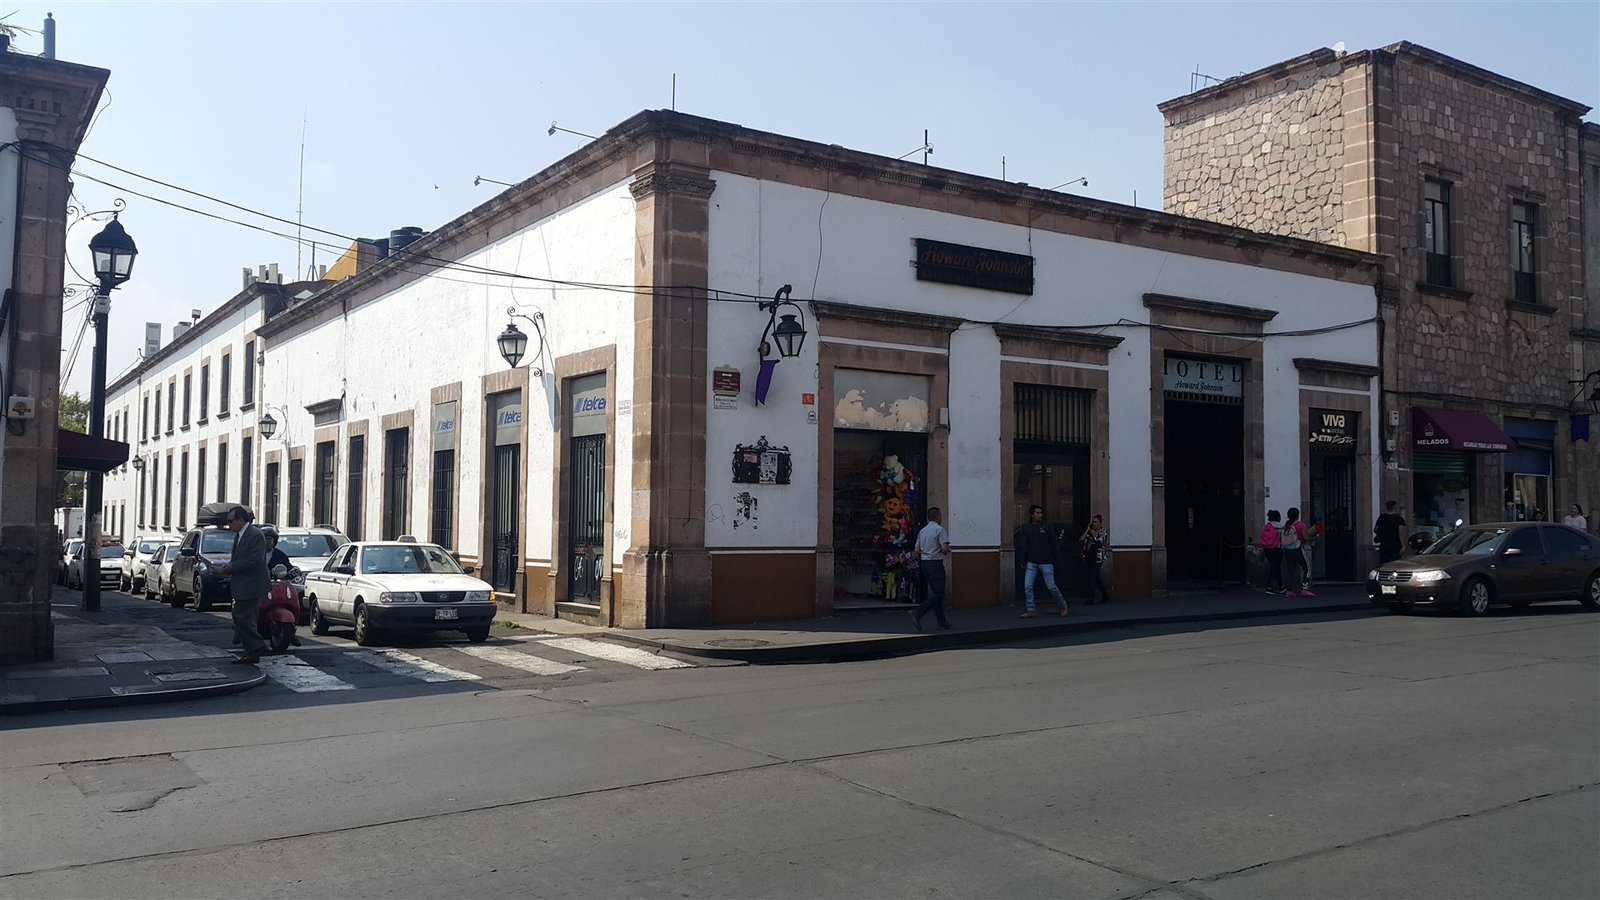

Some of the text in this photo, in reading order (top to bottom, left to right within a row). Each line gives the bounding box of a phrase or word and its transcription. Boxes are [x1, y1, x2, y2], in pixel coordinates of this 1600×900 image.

[1174, 380, 1223, 393] Howard Johnson
[582, 396, 606, 412] telce
[504, 410, 522, 424] telce
[1417, 438, 1450, 446] HELADOS
